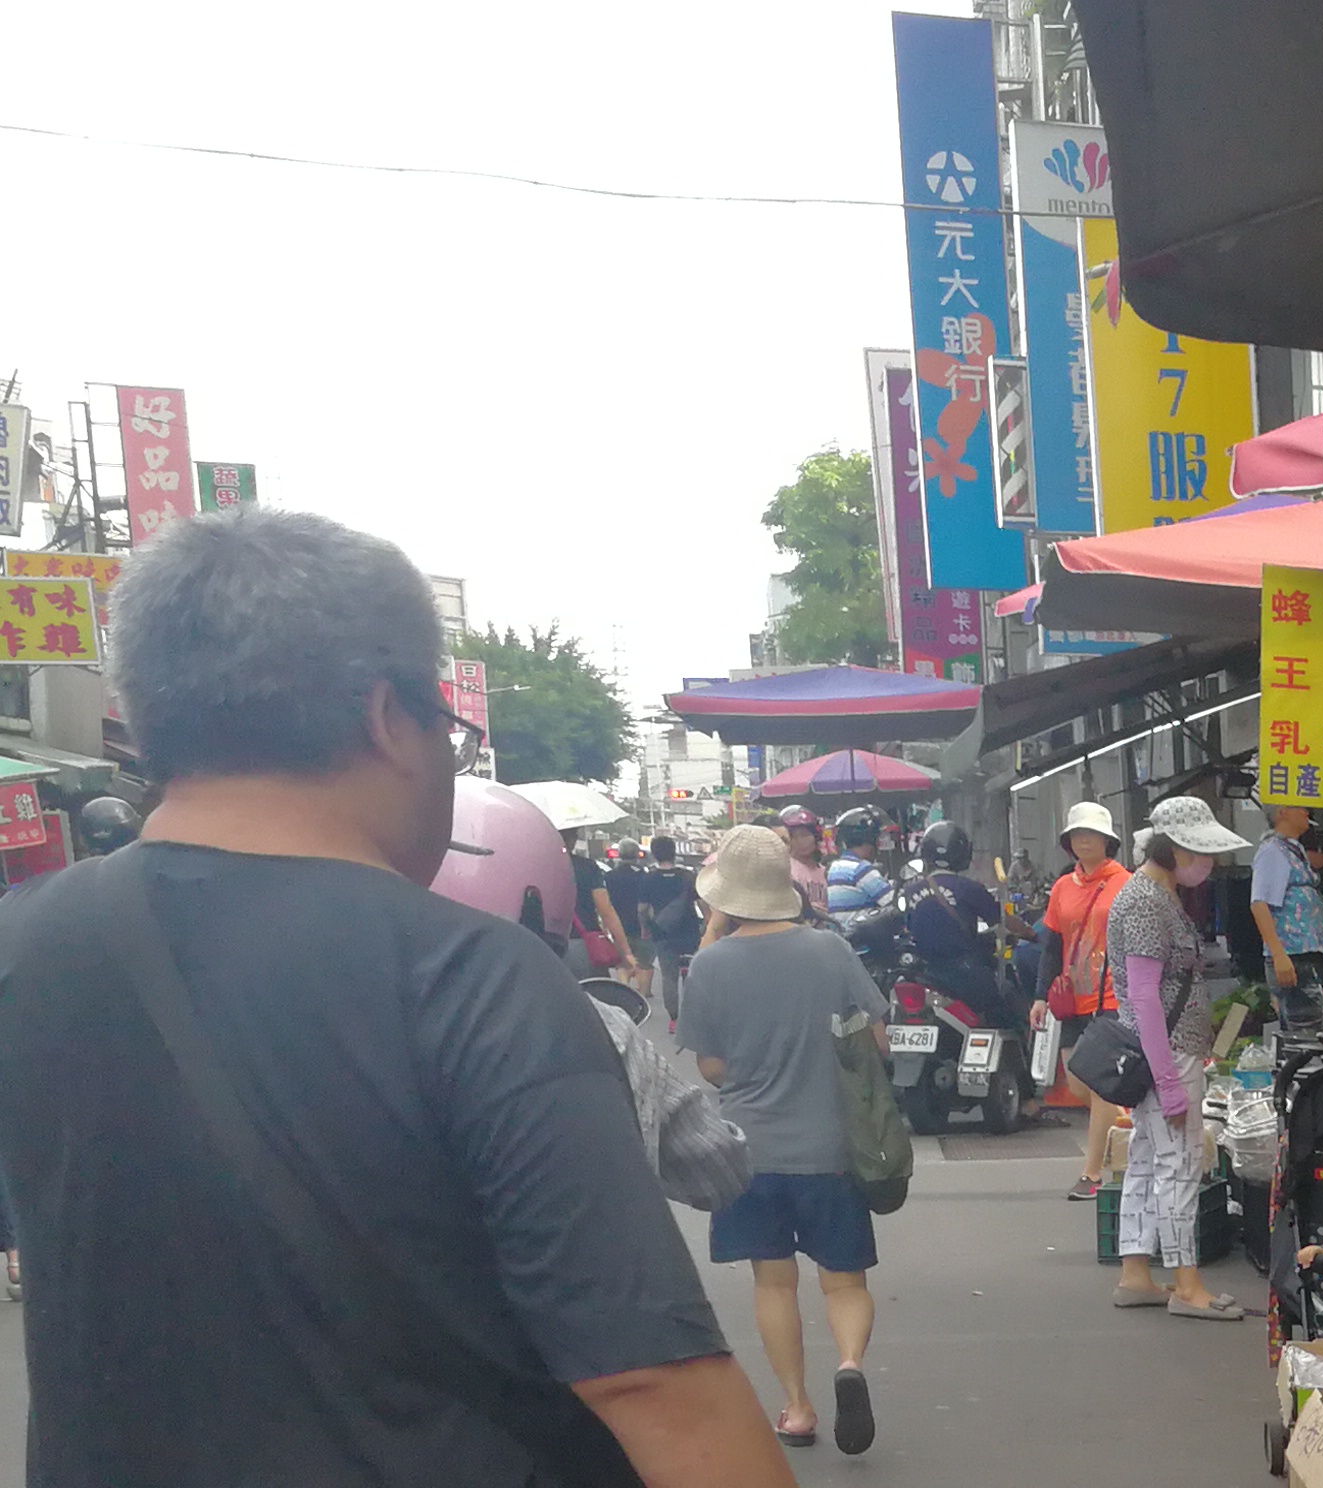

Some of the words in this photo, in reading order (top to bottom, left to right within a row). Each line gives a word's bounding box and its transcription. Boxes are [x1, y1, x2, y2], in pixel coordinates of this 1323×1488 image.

[935, 220, 987, 404] 元大銀行
[1270, 588, 1311, 758] 蜂王乳
